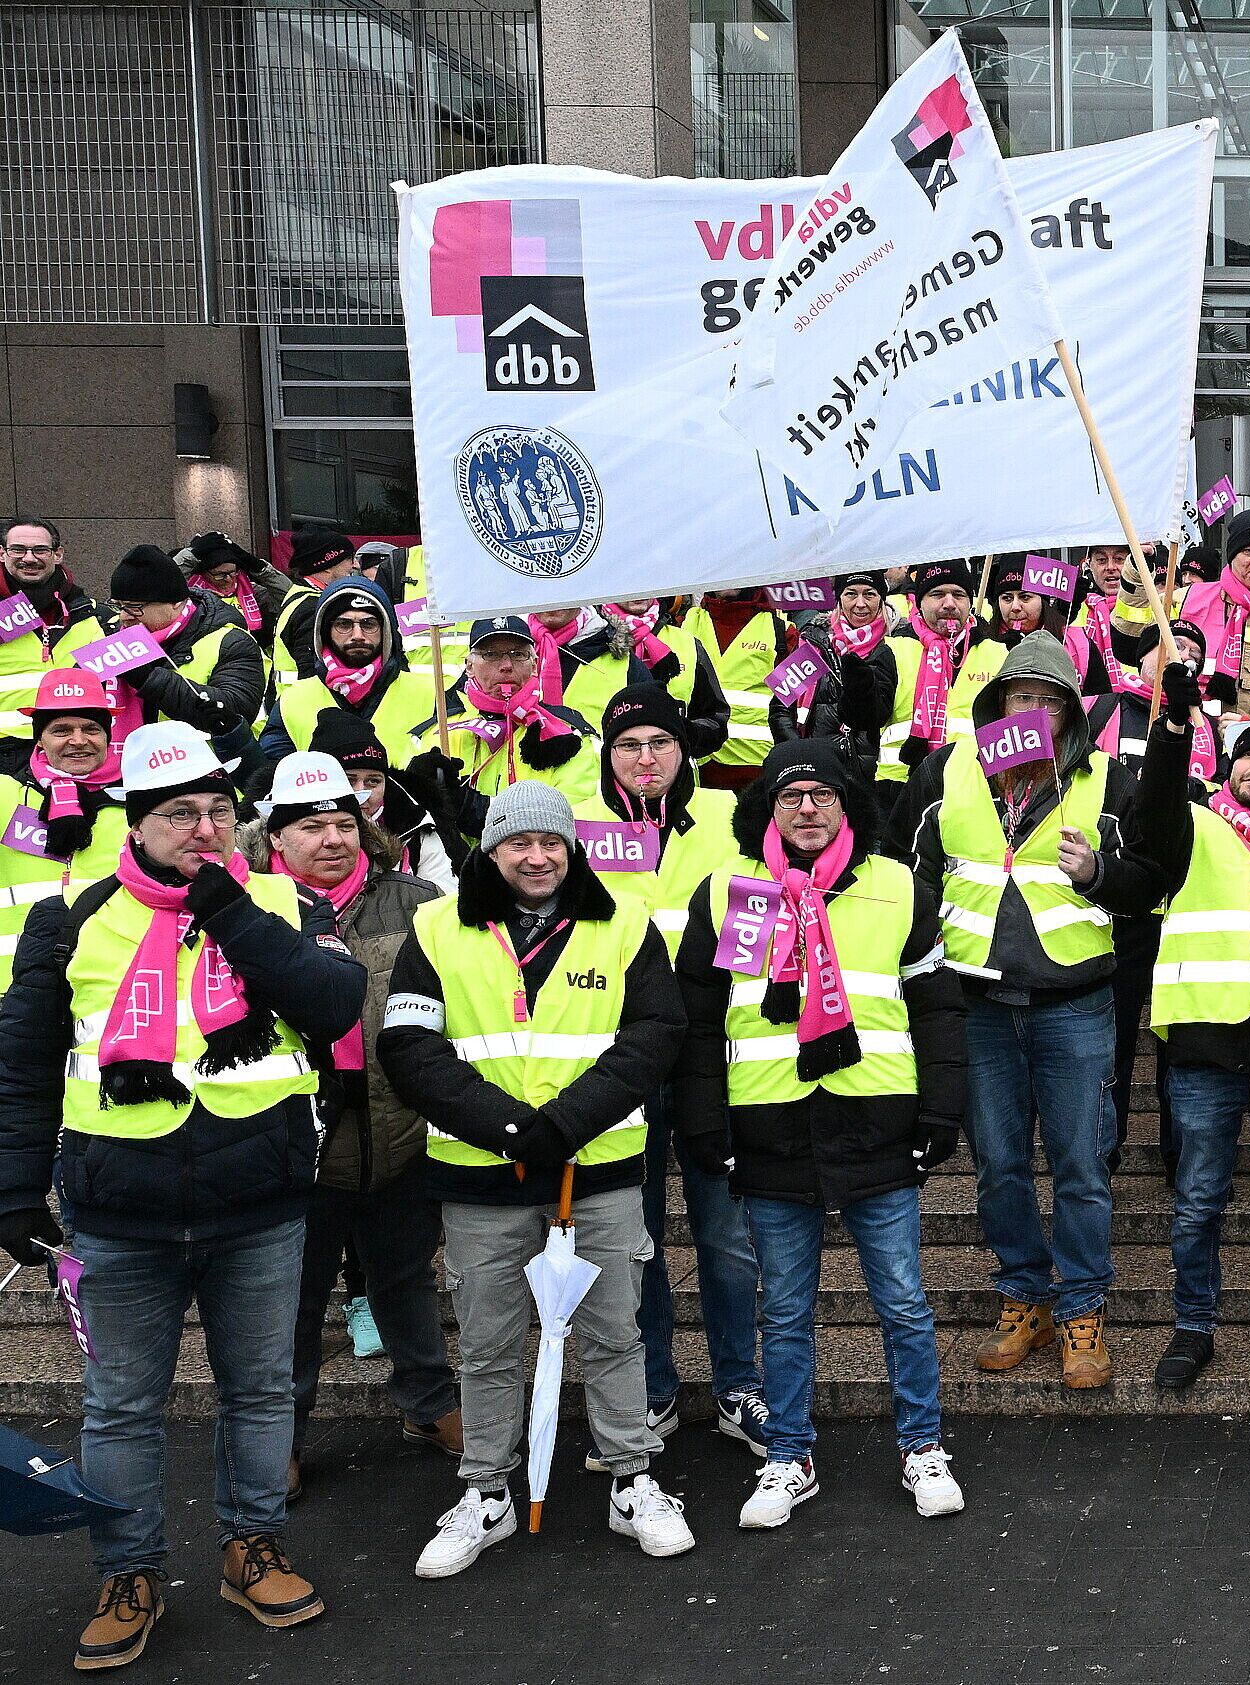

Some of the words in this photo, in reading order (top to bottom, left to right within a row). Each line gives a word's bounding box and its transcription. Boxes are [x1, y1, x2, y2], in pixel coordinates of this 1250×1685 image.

[694, 203, 795, 261] vdl
[494, 349, 581, 386] dbb
[783, 448, 941, 516] KLN
[1027, 567, 1069, 592] vdla
[83, 639, 150, 674] vdla
[53, 683, 85, 697] dbb
[774, 659, 818, 698] vdla
[149, 745, 187, 770] dbb
[980, 725, 1042, 765] vdla
[295, 769, 328, 787] dbb
[579, 831, 645, 861] vdla
[732, 894, 769, 966] vdla
